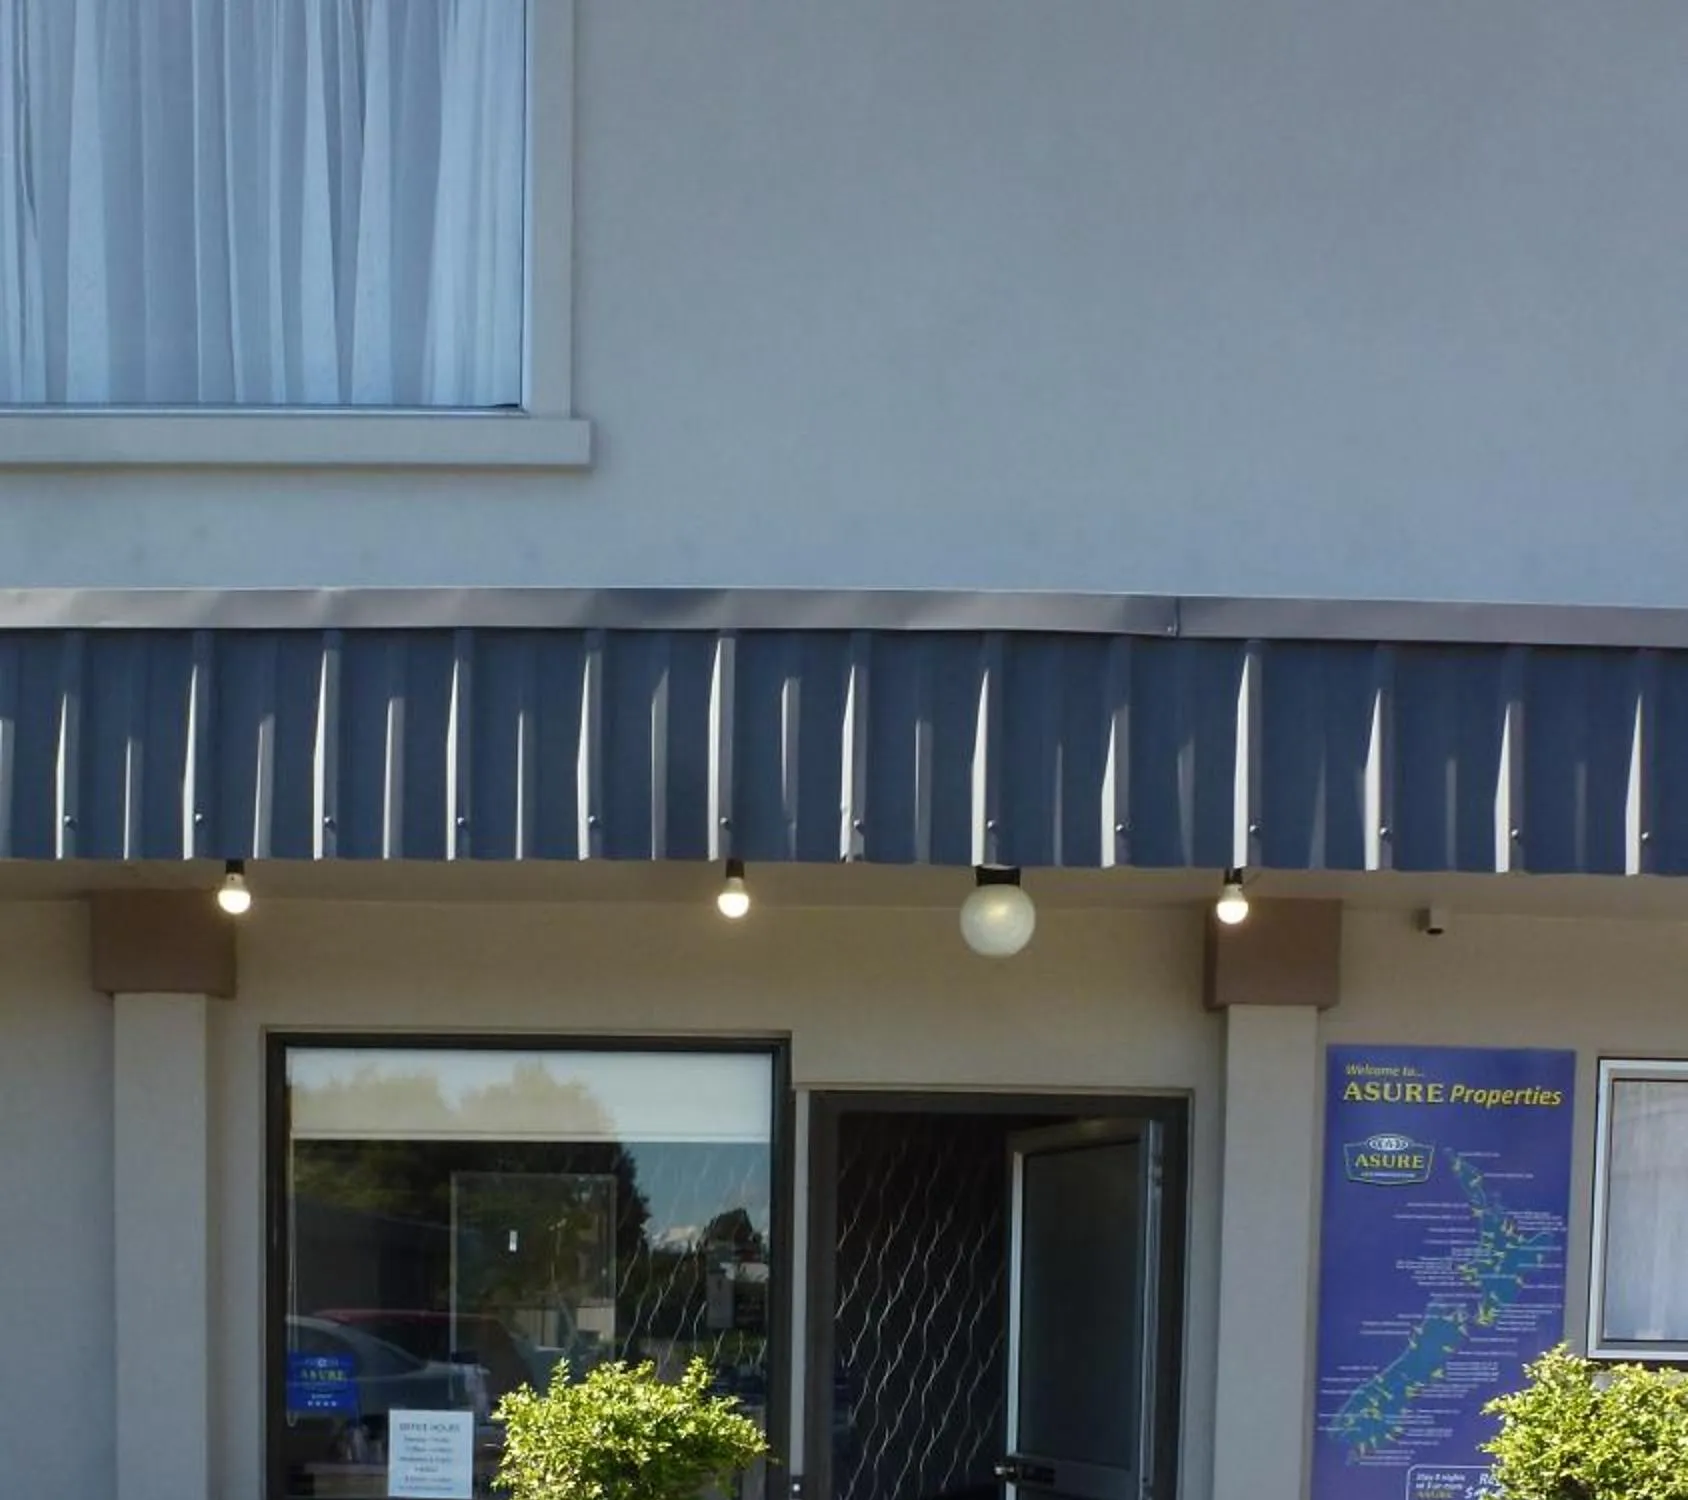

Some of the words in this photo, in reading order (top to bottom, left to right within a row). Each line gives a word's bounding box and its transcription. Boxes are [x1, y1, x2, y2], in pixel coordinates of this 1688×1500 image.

[1345, 1063, 1400, 1076] Welcome
[1343, 1081, 1444, 1102] ASURE
[1450, 1083, 1562, 1108] Properties
[1355, 1153, 1425, 1169] ASURE
